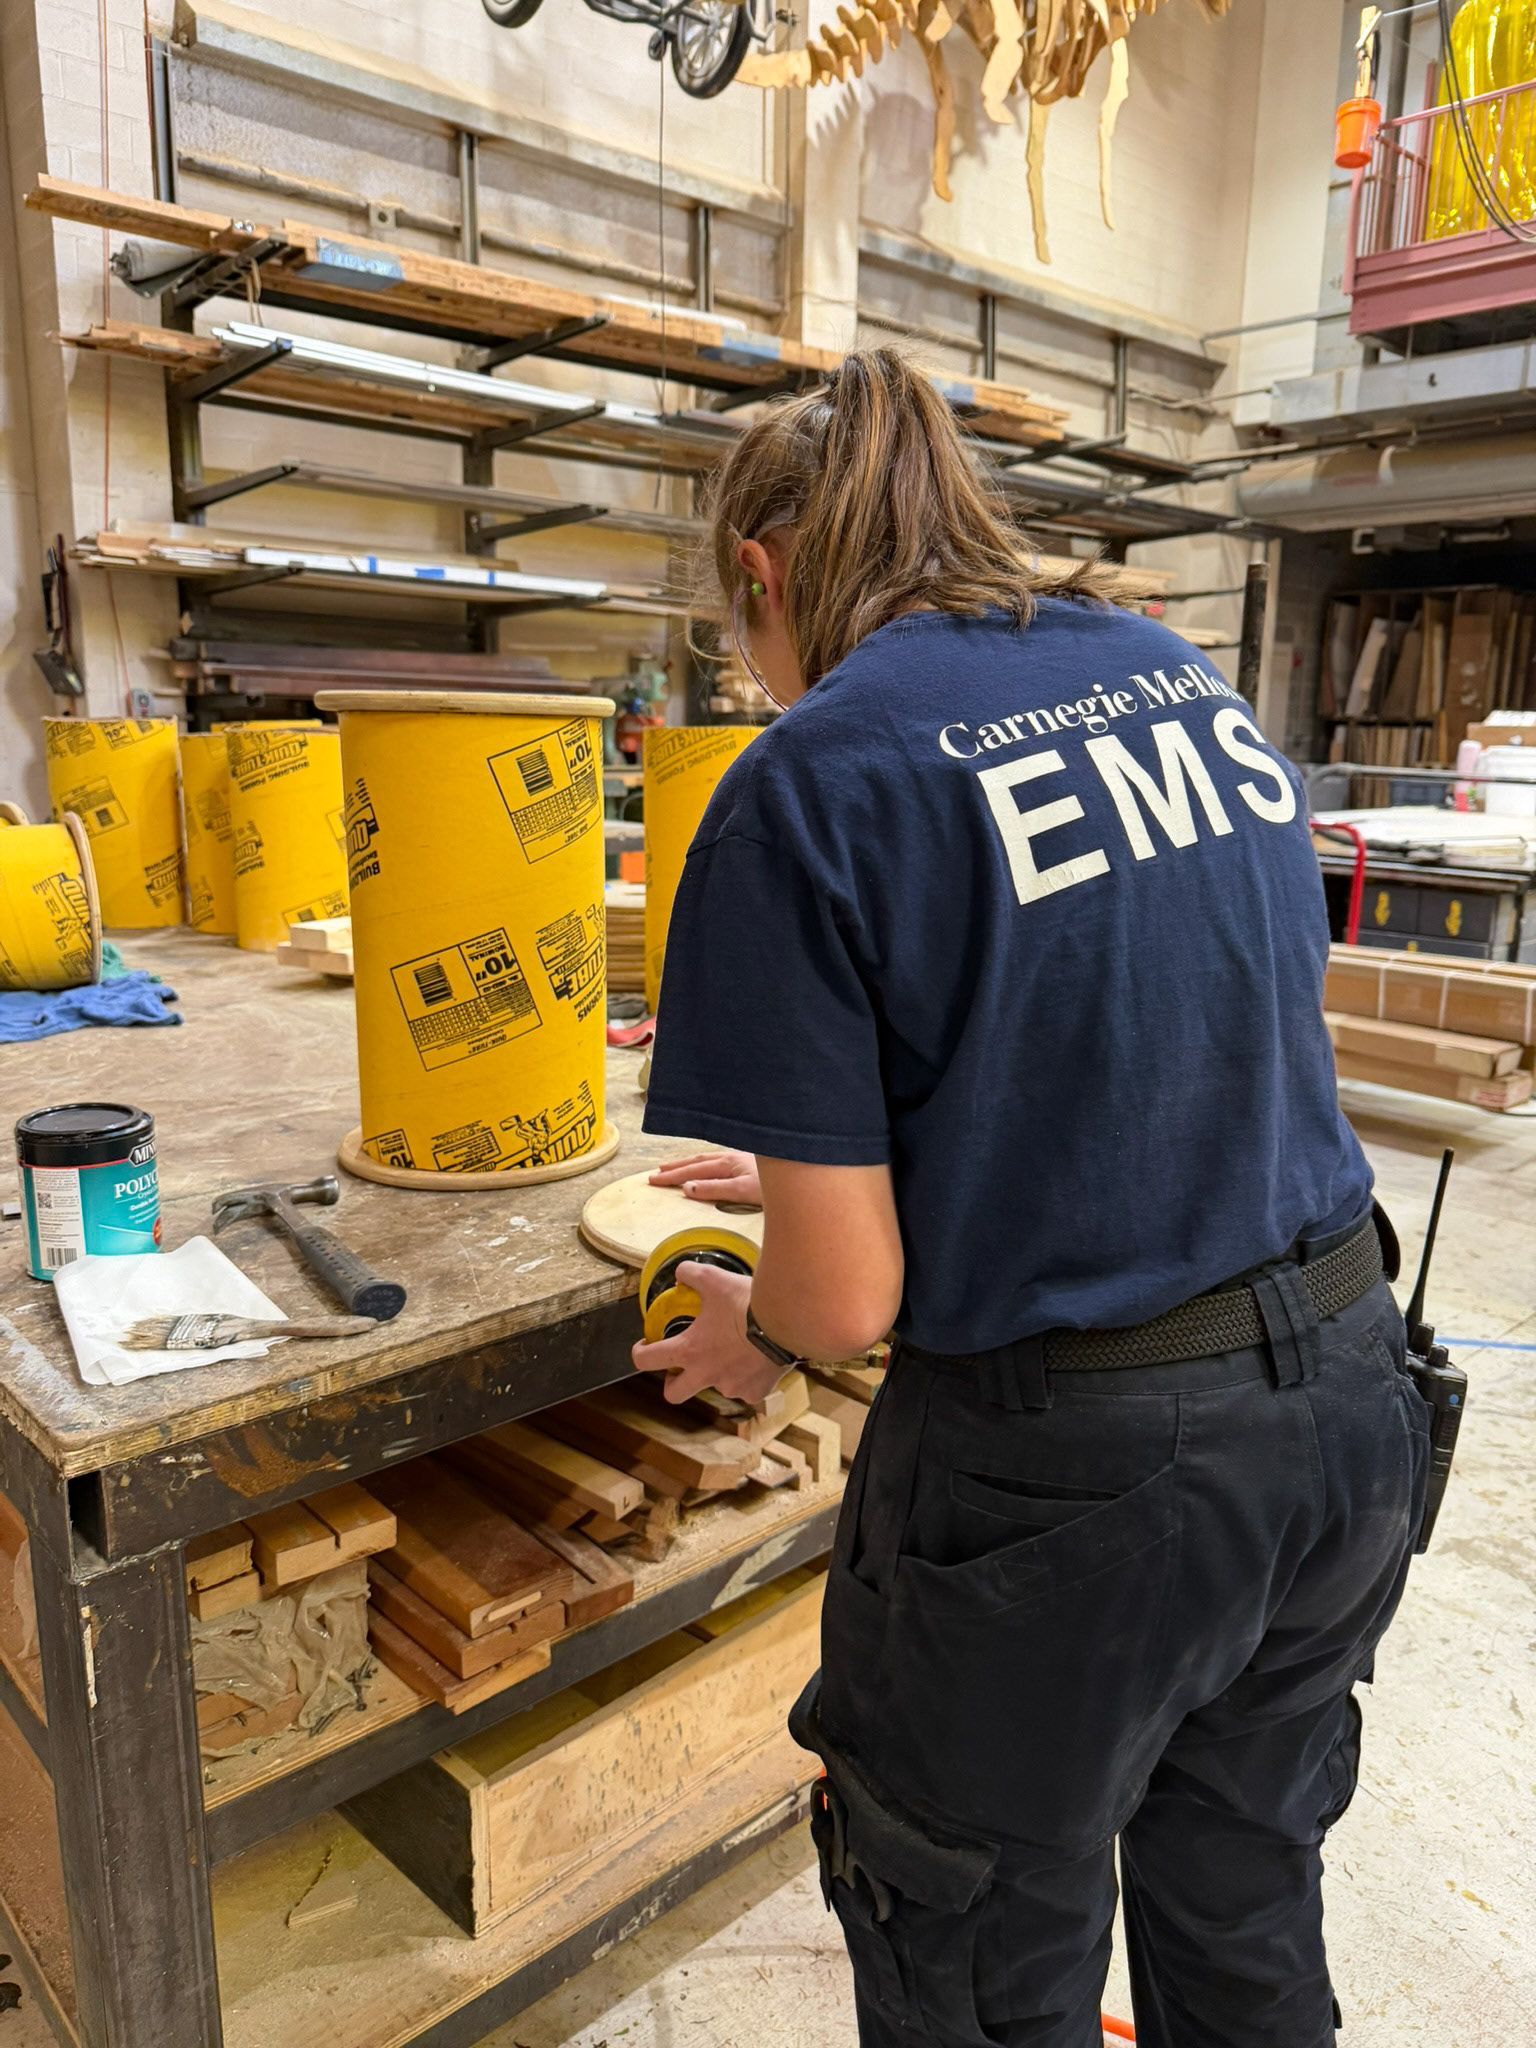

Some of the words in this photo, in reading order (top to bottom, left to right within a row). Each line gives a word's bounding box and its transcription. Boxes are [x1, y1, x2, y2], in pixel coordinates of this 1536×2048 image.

[939, 684, 1138, 759] Carnegie
[976, 708, 1296, 906] EMS
[475, 952, 517, 982] 10"
